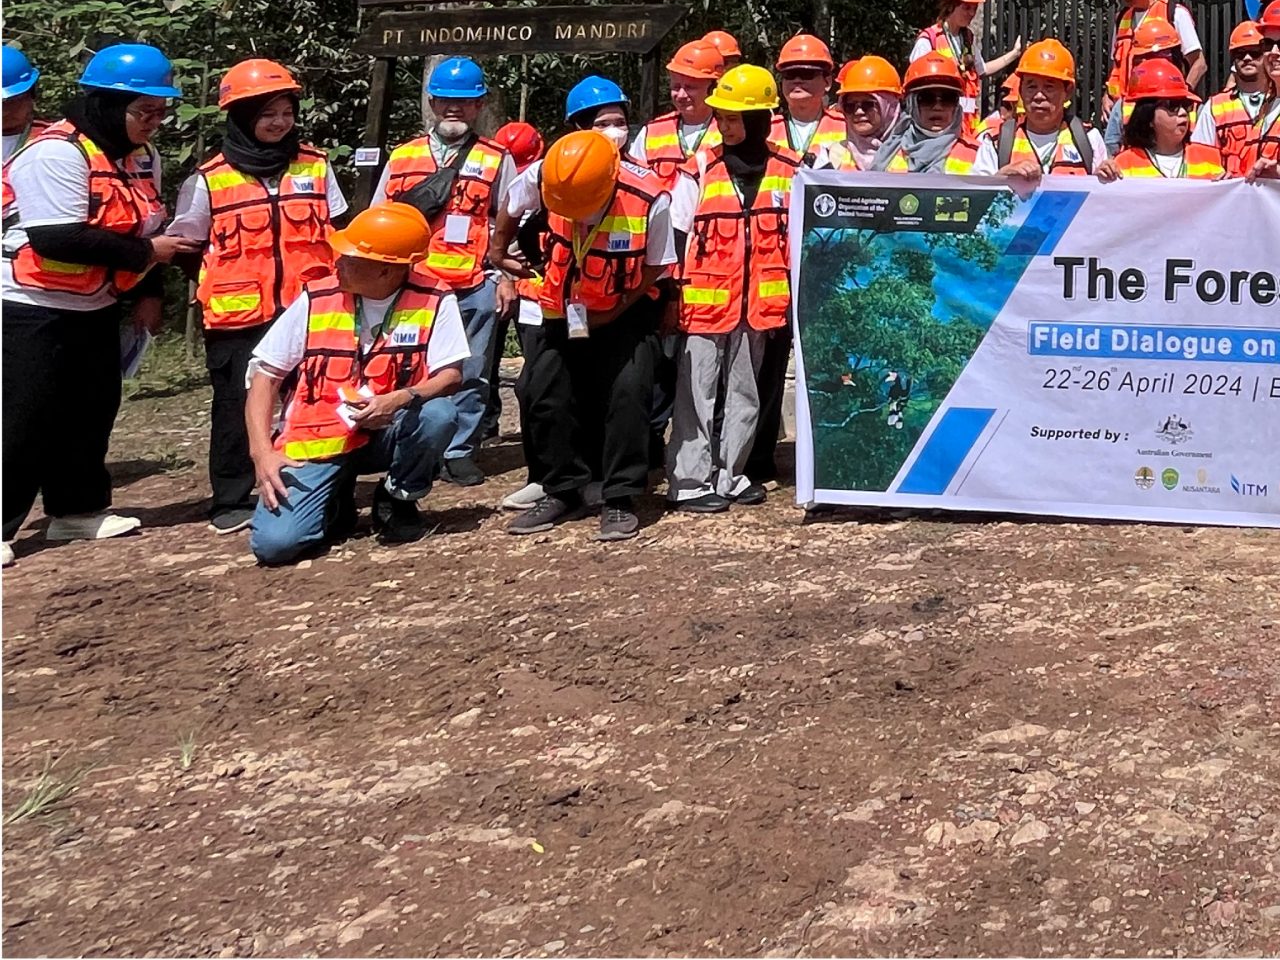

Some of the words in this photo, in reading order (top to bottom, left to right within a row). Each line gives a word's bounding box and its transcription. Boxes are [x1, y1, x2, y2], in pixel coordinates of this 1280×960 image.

[419, 26, 533, 43] INDOMINCO
[555, 22, 647, 40] MANDIRI
[611, 239, 630, 250] IMM
[1053, 256, 1146, 302] The
[1034, 326, 1101, 351] Field
[1111, 328, 1232, 359] Dialogue
[1243, 338, 1276, 358] on
[1118, 371, 1175, 397] April
[1183, 373, 1242, 396] 2024
[1030, 426, 1101, 441] Supported
[1104, 429, 1121, 443] by
[1136, 448, 1170, 457] Australian
[1171, 450, 1213, 459] Government
[1242, 483, 1268, 497] ITM
